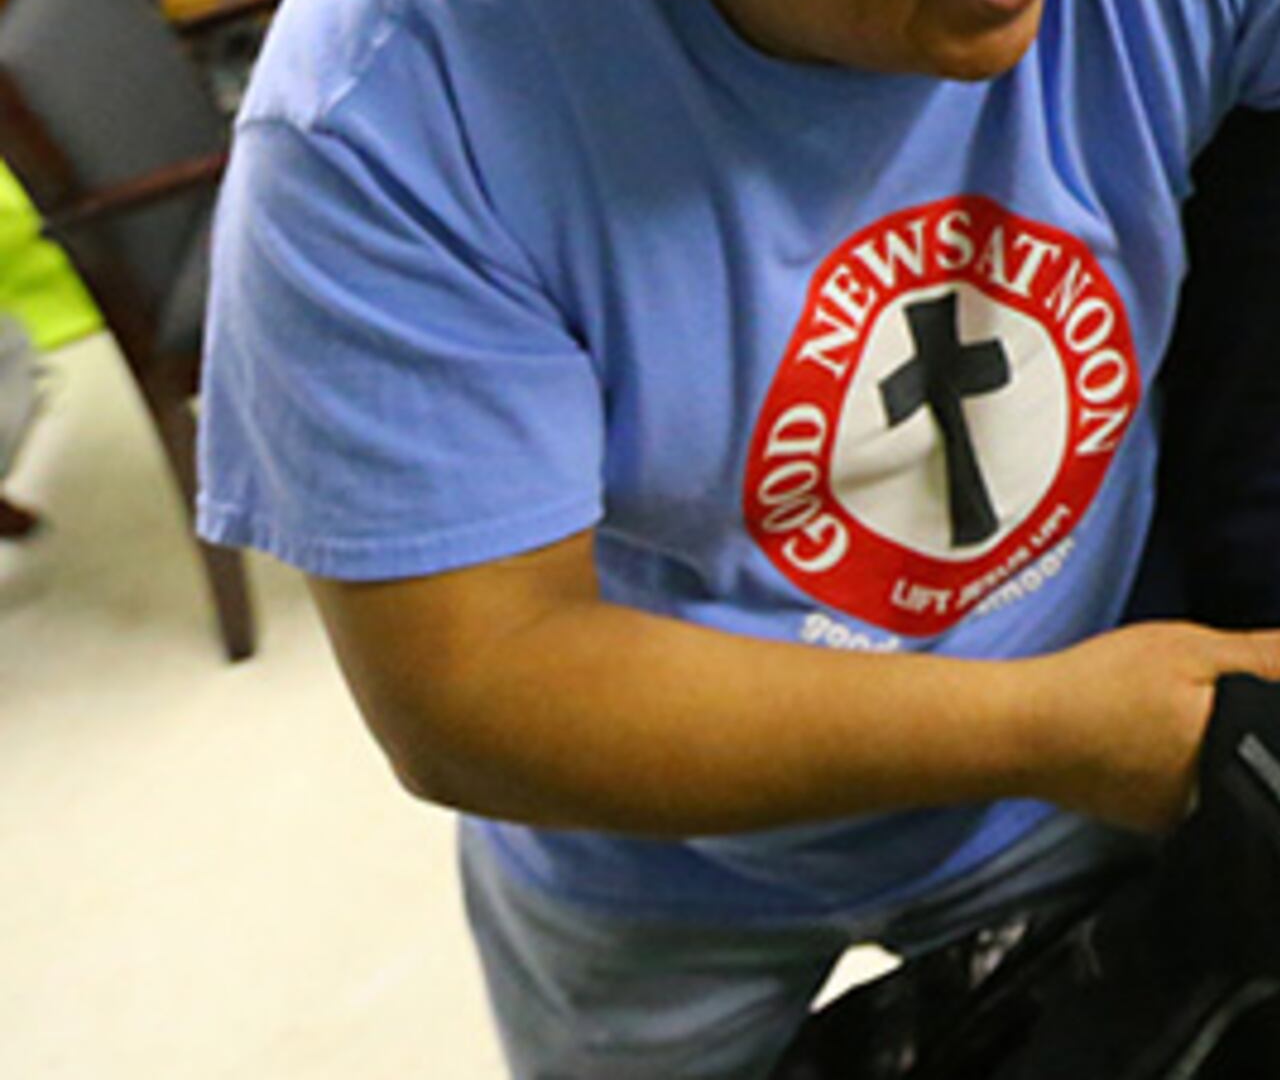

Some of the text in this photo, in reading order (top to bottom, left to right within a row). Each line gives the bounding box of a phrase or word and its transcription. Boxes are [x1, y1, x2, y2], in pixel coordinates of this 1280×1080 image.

[757, 210, 1129, 573] GOOD NEWS AT NOON
[890, 576, 953, 615] LIFT
